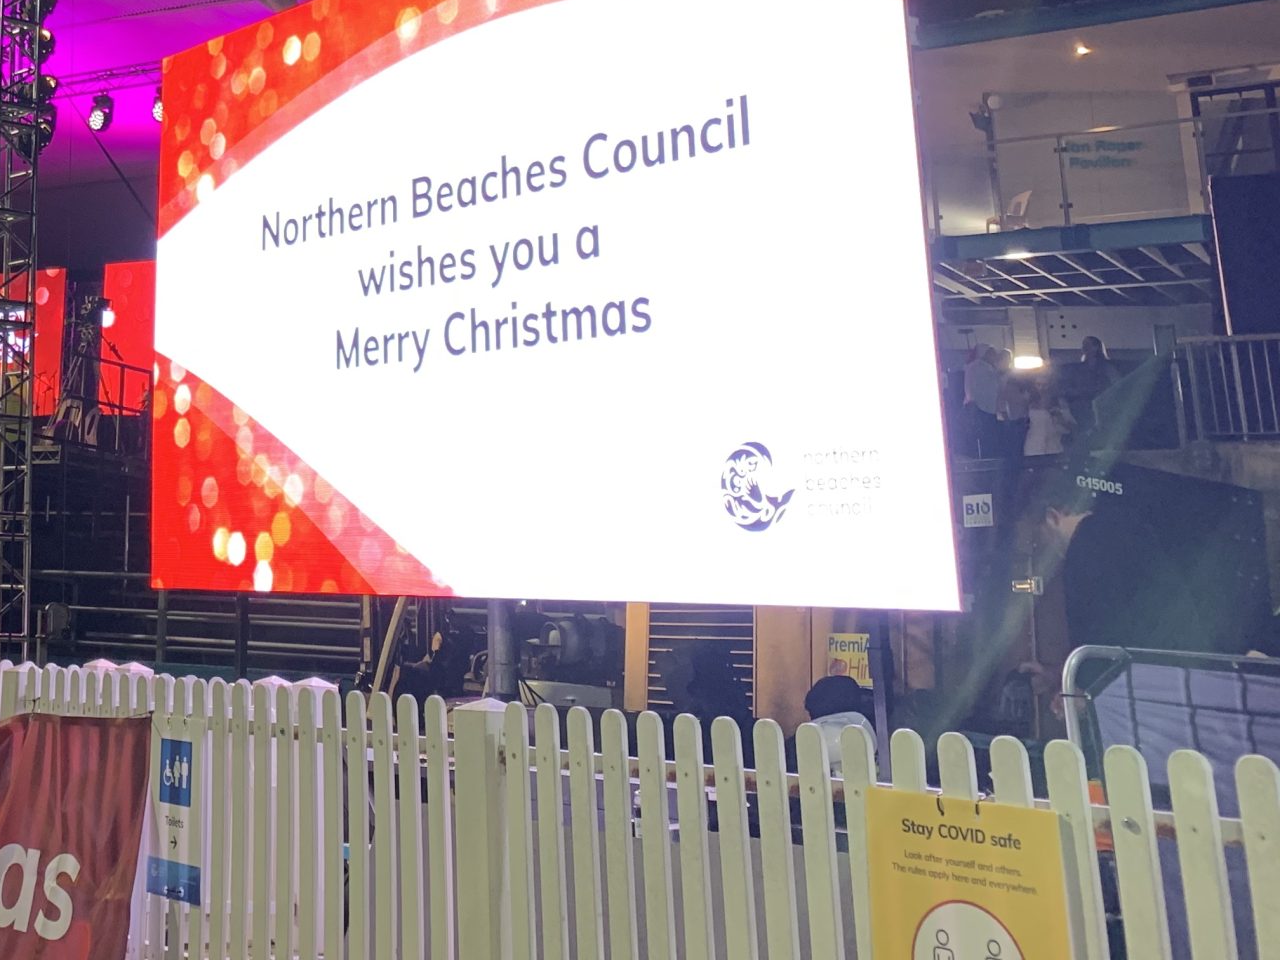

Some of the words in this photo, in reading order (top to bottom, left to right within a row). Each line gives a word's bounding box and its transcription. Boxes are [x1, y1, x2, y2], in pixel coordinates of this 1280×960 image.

[262, 195, 398, 251] Northern
[412, 155, 568, 218] Beaches
[583, 94, 751, 179] Council
[358, 245, 477, 296] wishes
[489, 232, 559, 288] you
[576, 224, 600, 260] a
[336, 327, 431, 373] Merry
[444, 296, 652, 356] Christmas
[1076, 475, 1123, 495] G15005
[165, 815, 184, 829] Toilets
[901, 818, 934, 840] Stay
[938, 823, 986, 844] COVID
[990, 833, 1022, 850] safe
[892, 862, 907, 873] The
[928, 869, 950, 881] apply
[971, 876, 987, 887] and
[904, 849, 923, 860] Look
[924, 853, 943, 863] after
[978, 861, 994, 873] and
